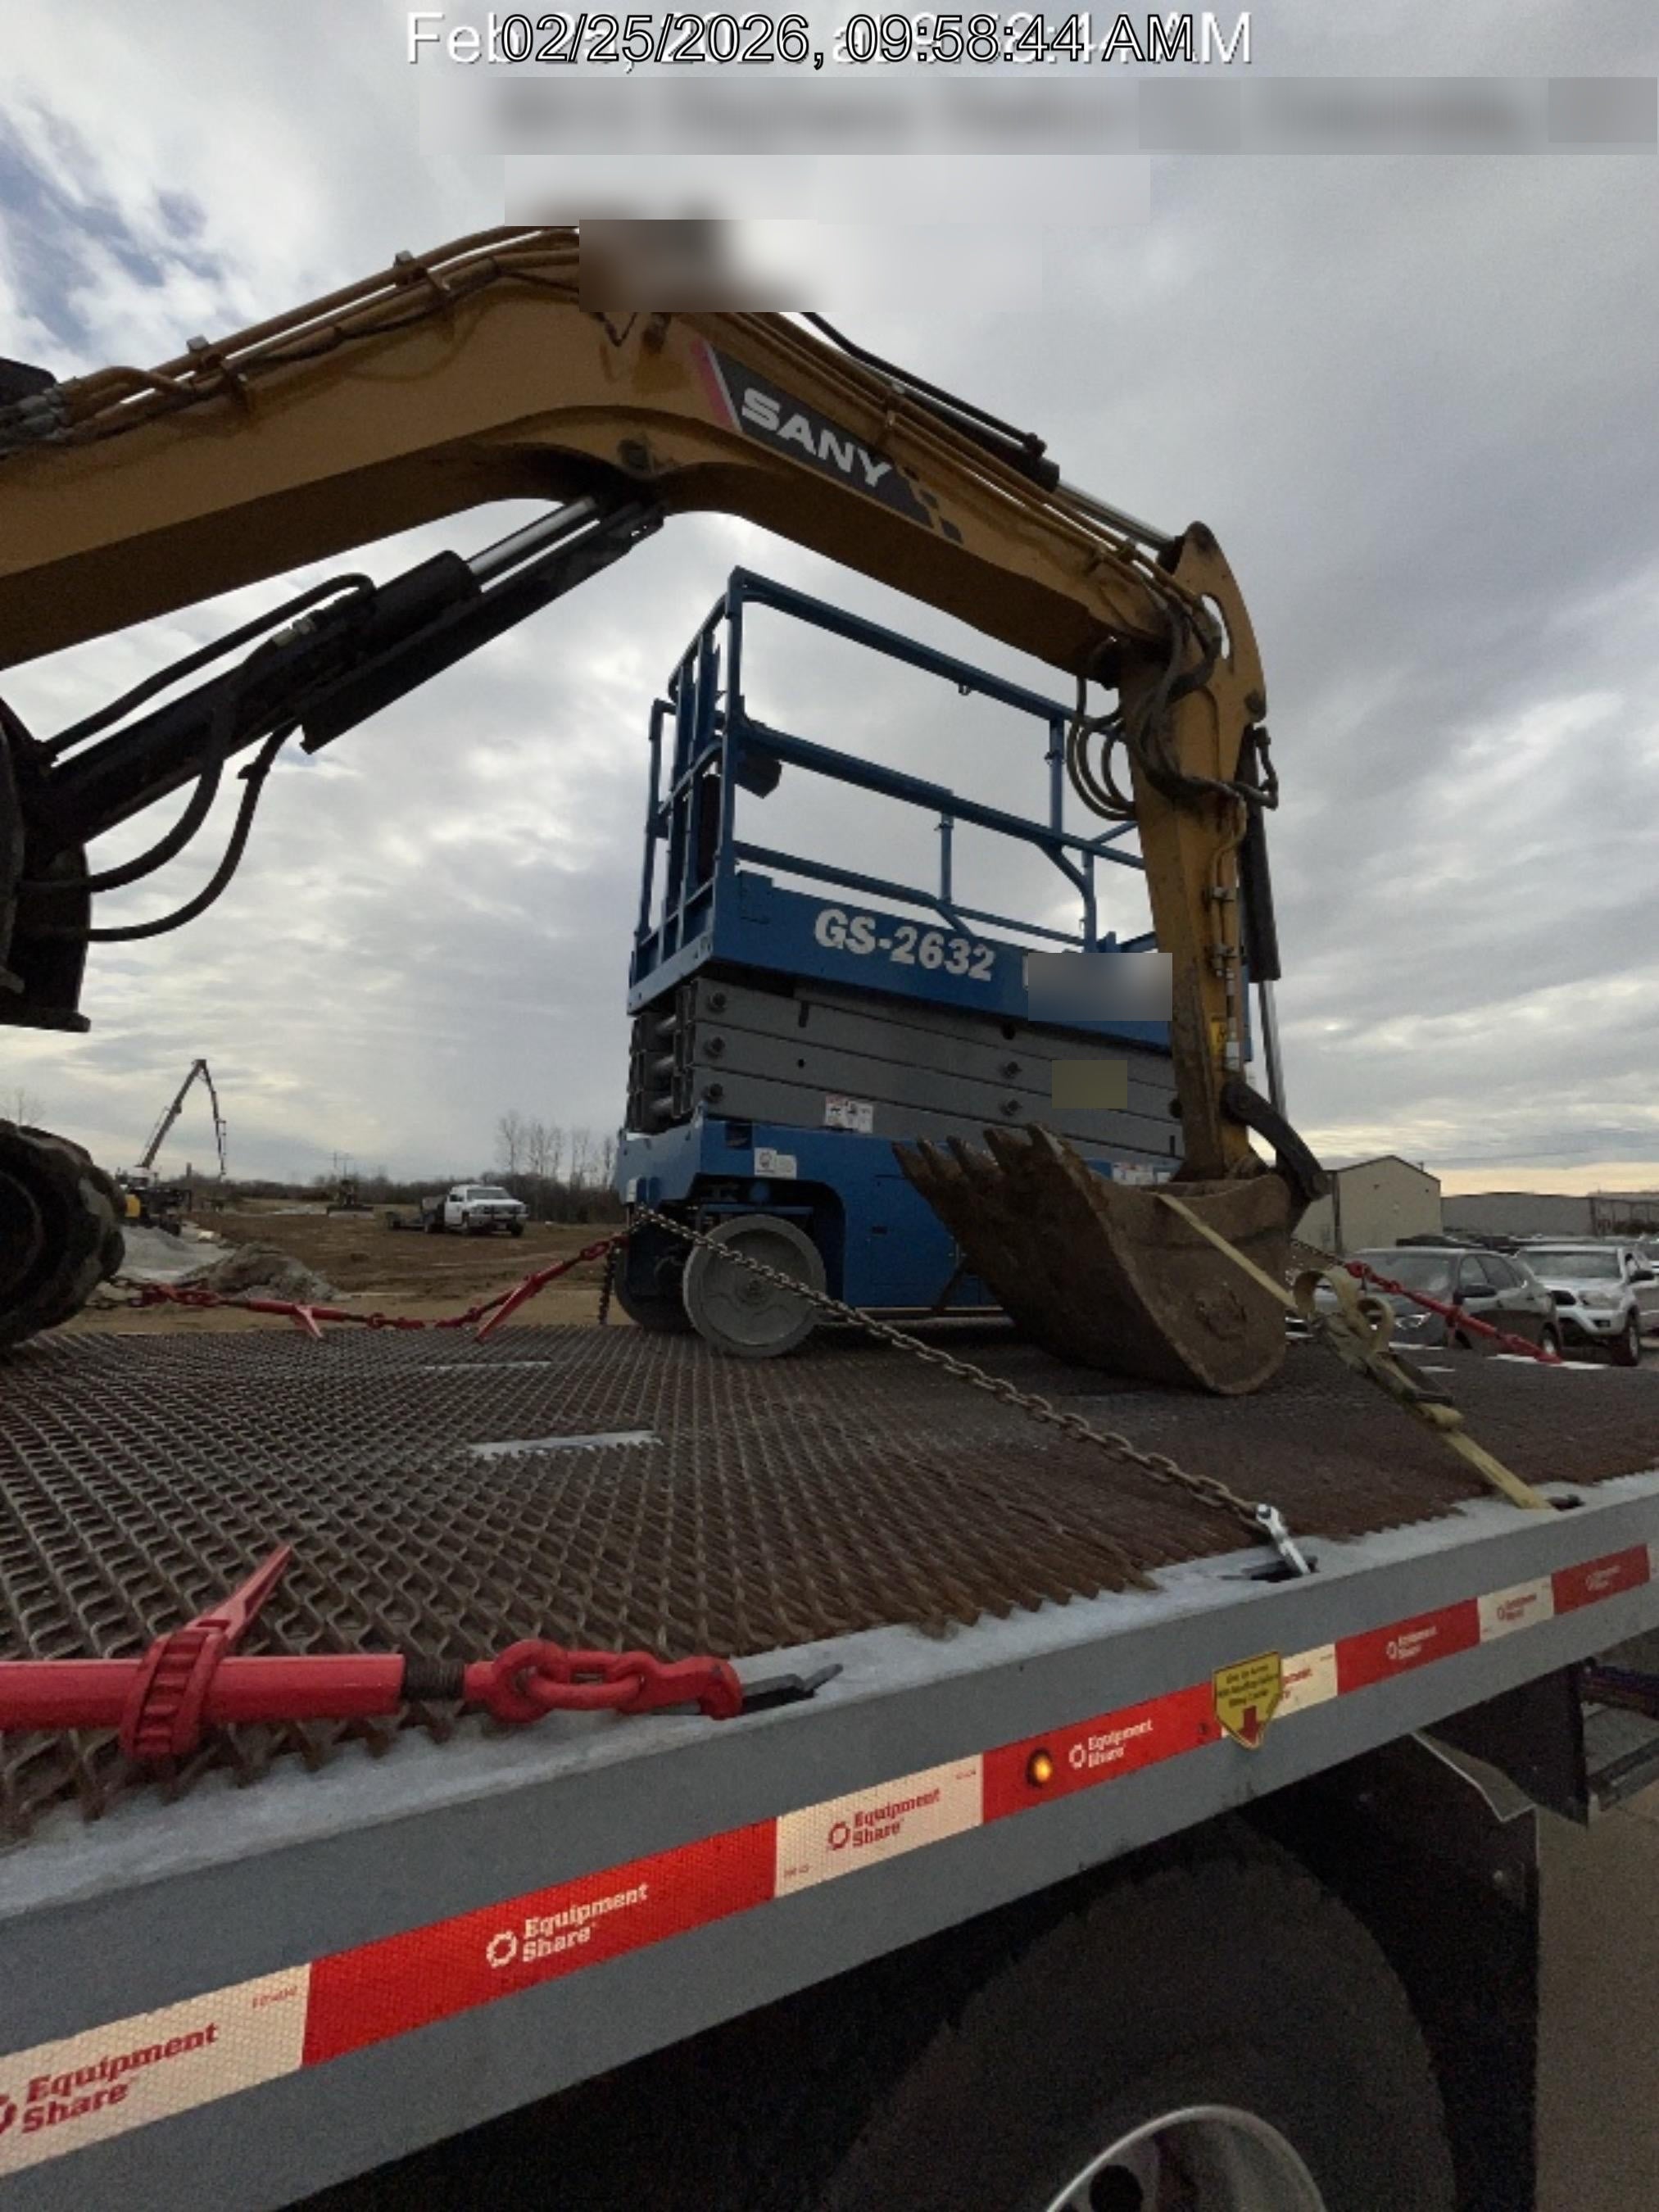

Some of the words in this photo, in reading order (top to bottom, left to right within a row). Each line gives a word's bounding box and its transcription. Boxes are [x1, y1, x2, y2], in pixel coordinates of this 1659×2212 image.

[741, 388, 892, 487] SANY
[814, 908, 996, 981] GS-2632
[852, 1820, 900, 1848] Share
[853, 1788, 940, 1828] Equipment
[524, 1883, 649, 1939] Equipment
[522, 1926, 591, 1962] Share
[26, 2022, 219, 2103] Equipment
[21, 2083, 129, 2134] Share
